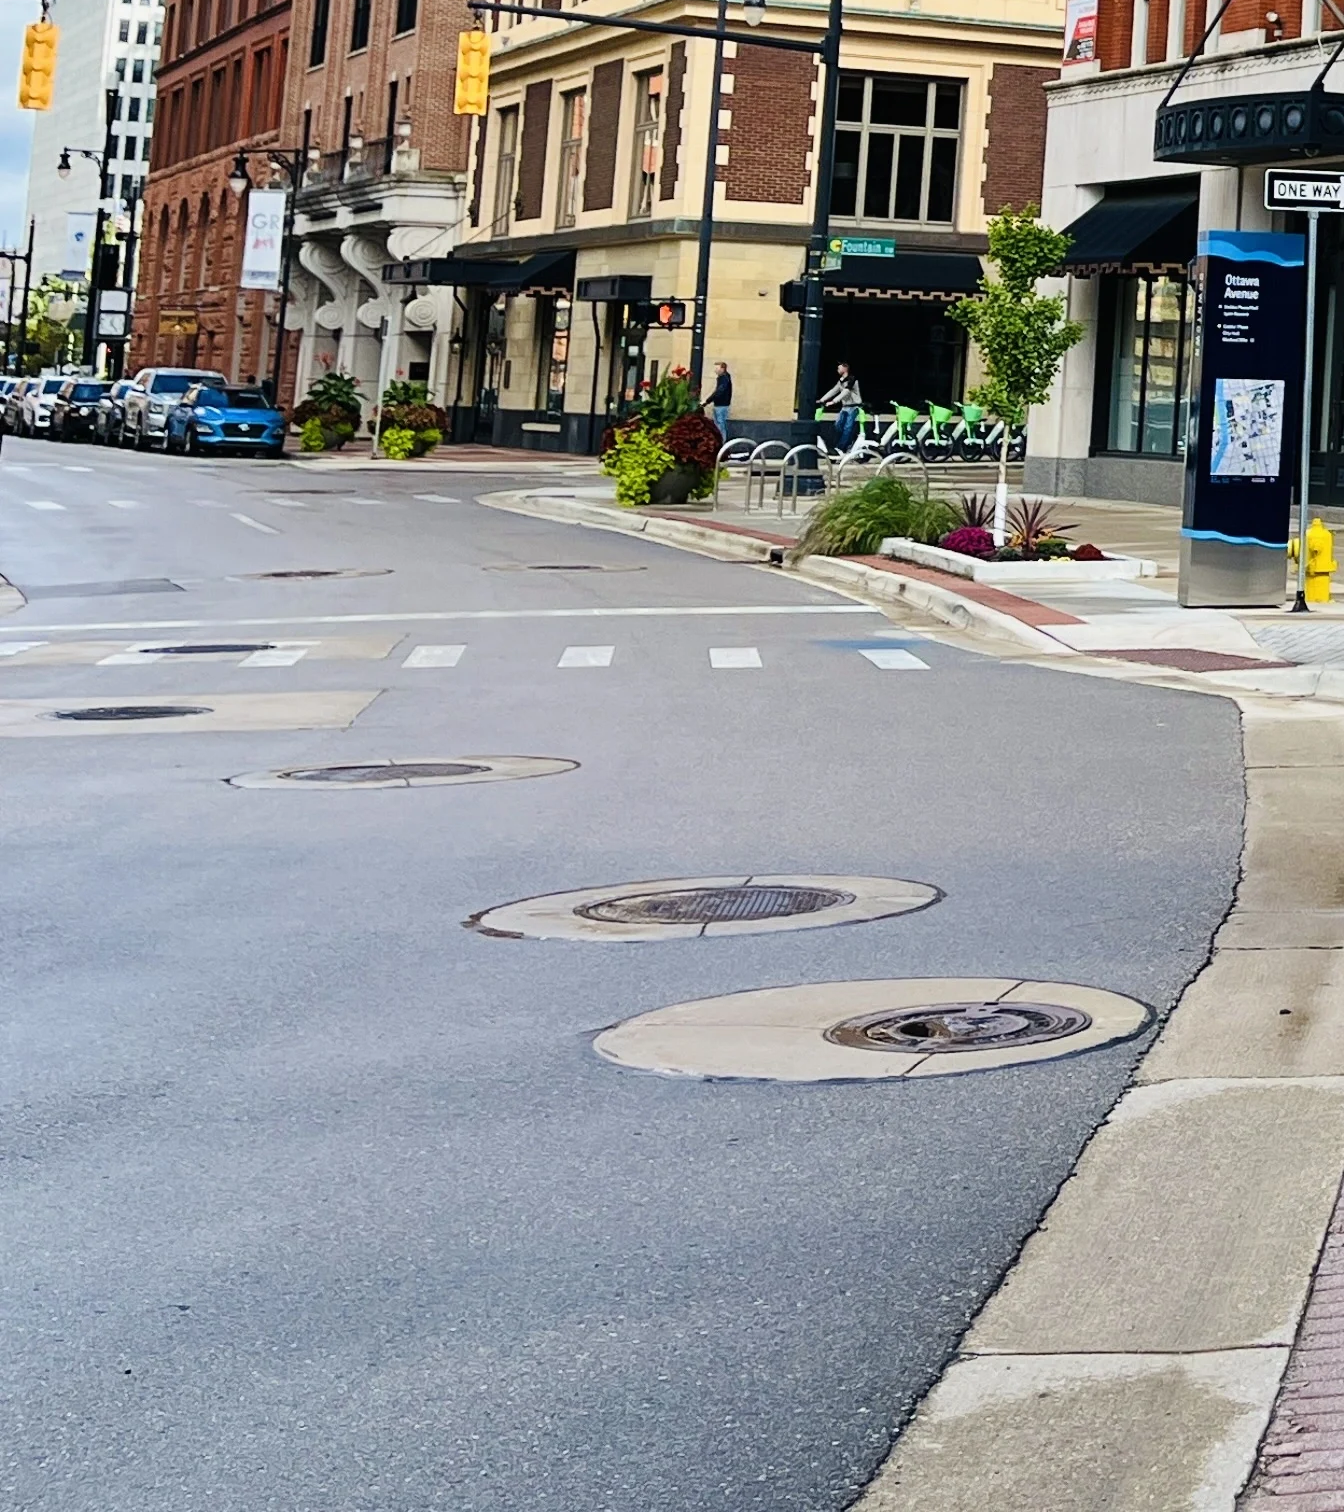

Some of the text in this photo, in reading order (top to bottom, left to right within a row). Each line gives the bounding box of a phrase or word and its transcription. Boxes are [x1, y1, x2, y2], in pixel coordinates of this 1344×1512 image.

[1277, 182, 1340, 198] ONE WAY
[841, 239, 881, 254] Fountain
[1225, 273, 1260, 287] Ottawa
[1224, 287, 1259, 300] Avenue
